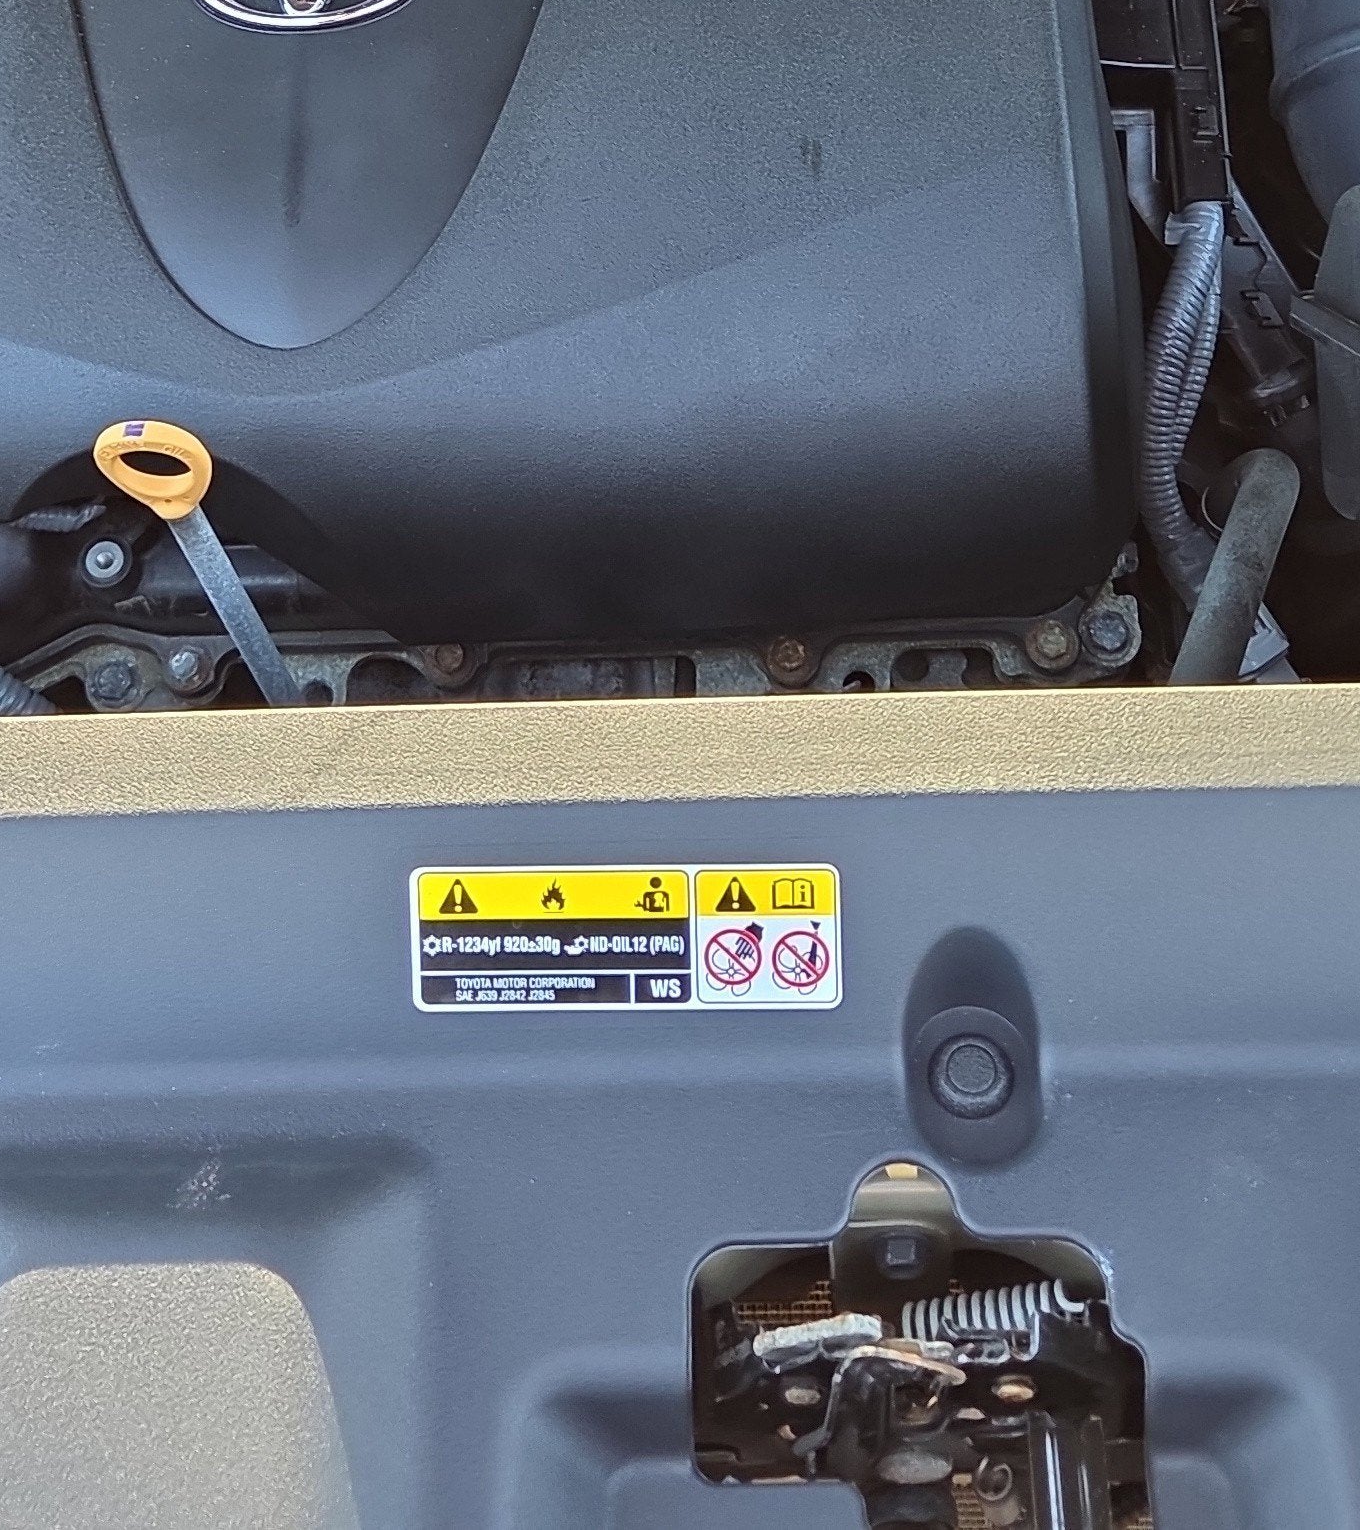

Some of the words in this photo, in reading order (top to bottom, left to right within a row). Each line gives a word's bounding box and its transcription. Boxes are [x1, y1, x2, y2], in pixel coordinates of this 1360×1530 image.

[649, 935, 685, 956] (PAG)
[455, 977, 492, 989] TOYOTA
[492, 977, 528, 989] MOTOR
[528, 976, 596, 989] CORPORATION
[649, 978, 682, 999] WS
[455, 990, 475, 1002] SAE
